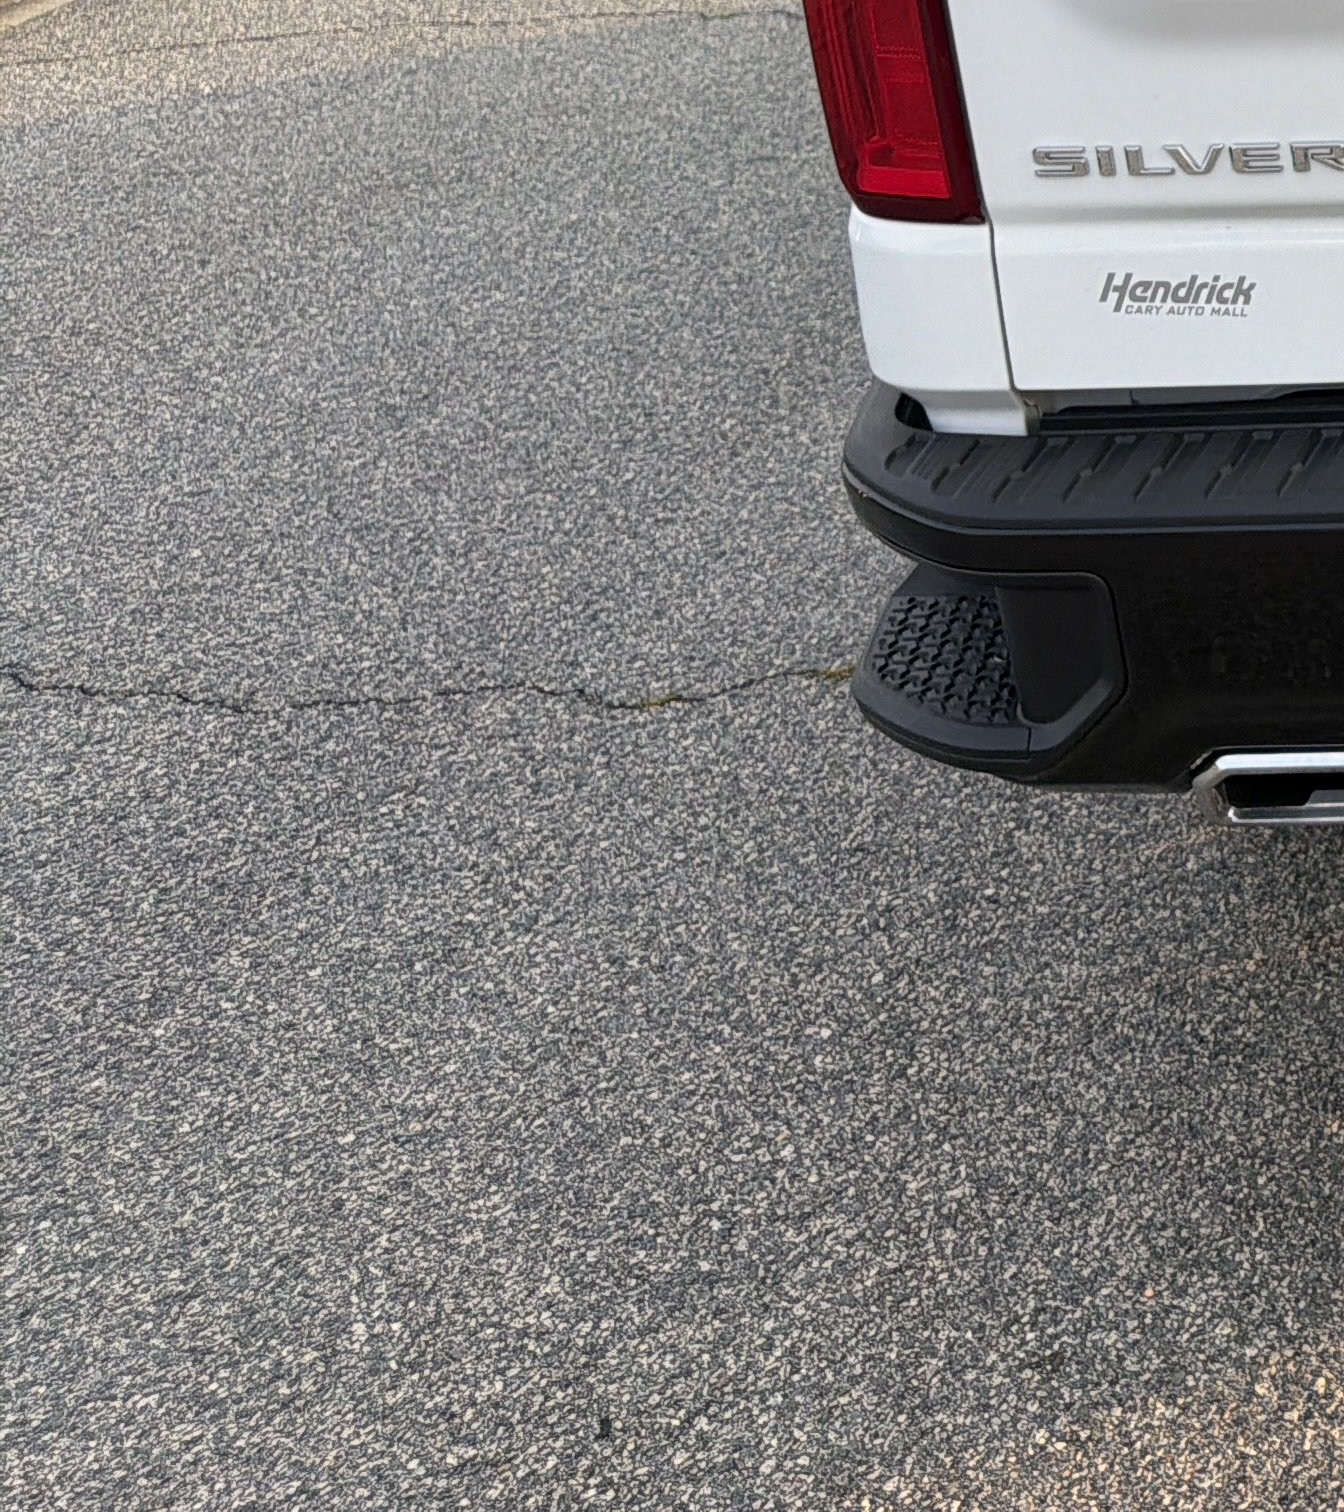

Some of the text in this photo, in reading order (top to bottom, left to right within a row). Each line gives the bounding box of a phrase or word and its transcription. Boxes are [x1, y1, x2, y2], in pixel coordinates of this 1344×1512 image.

[1099, 272, 1257, 313] Hendrick
[1124, 304, 1249, 318] CARY AUTO MALL
